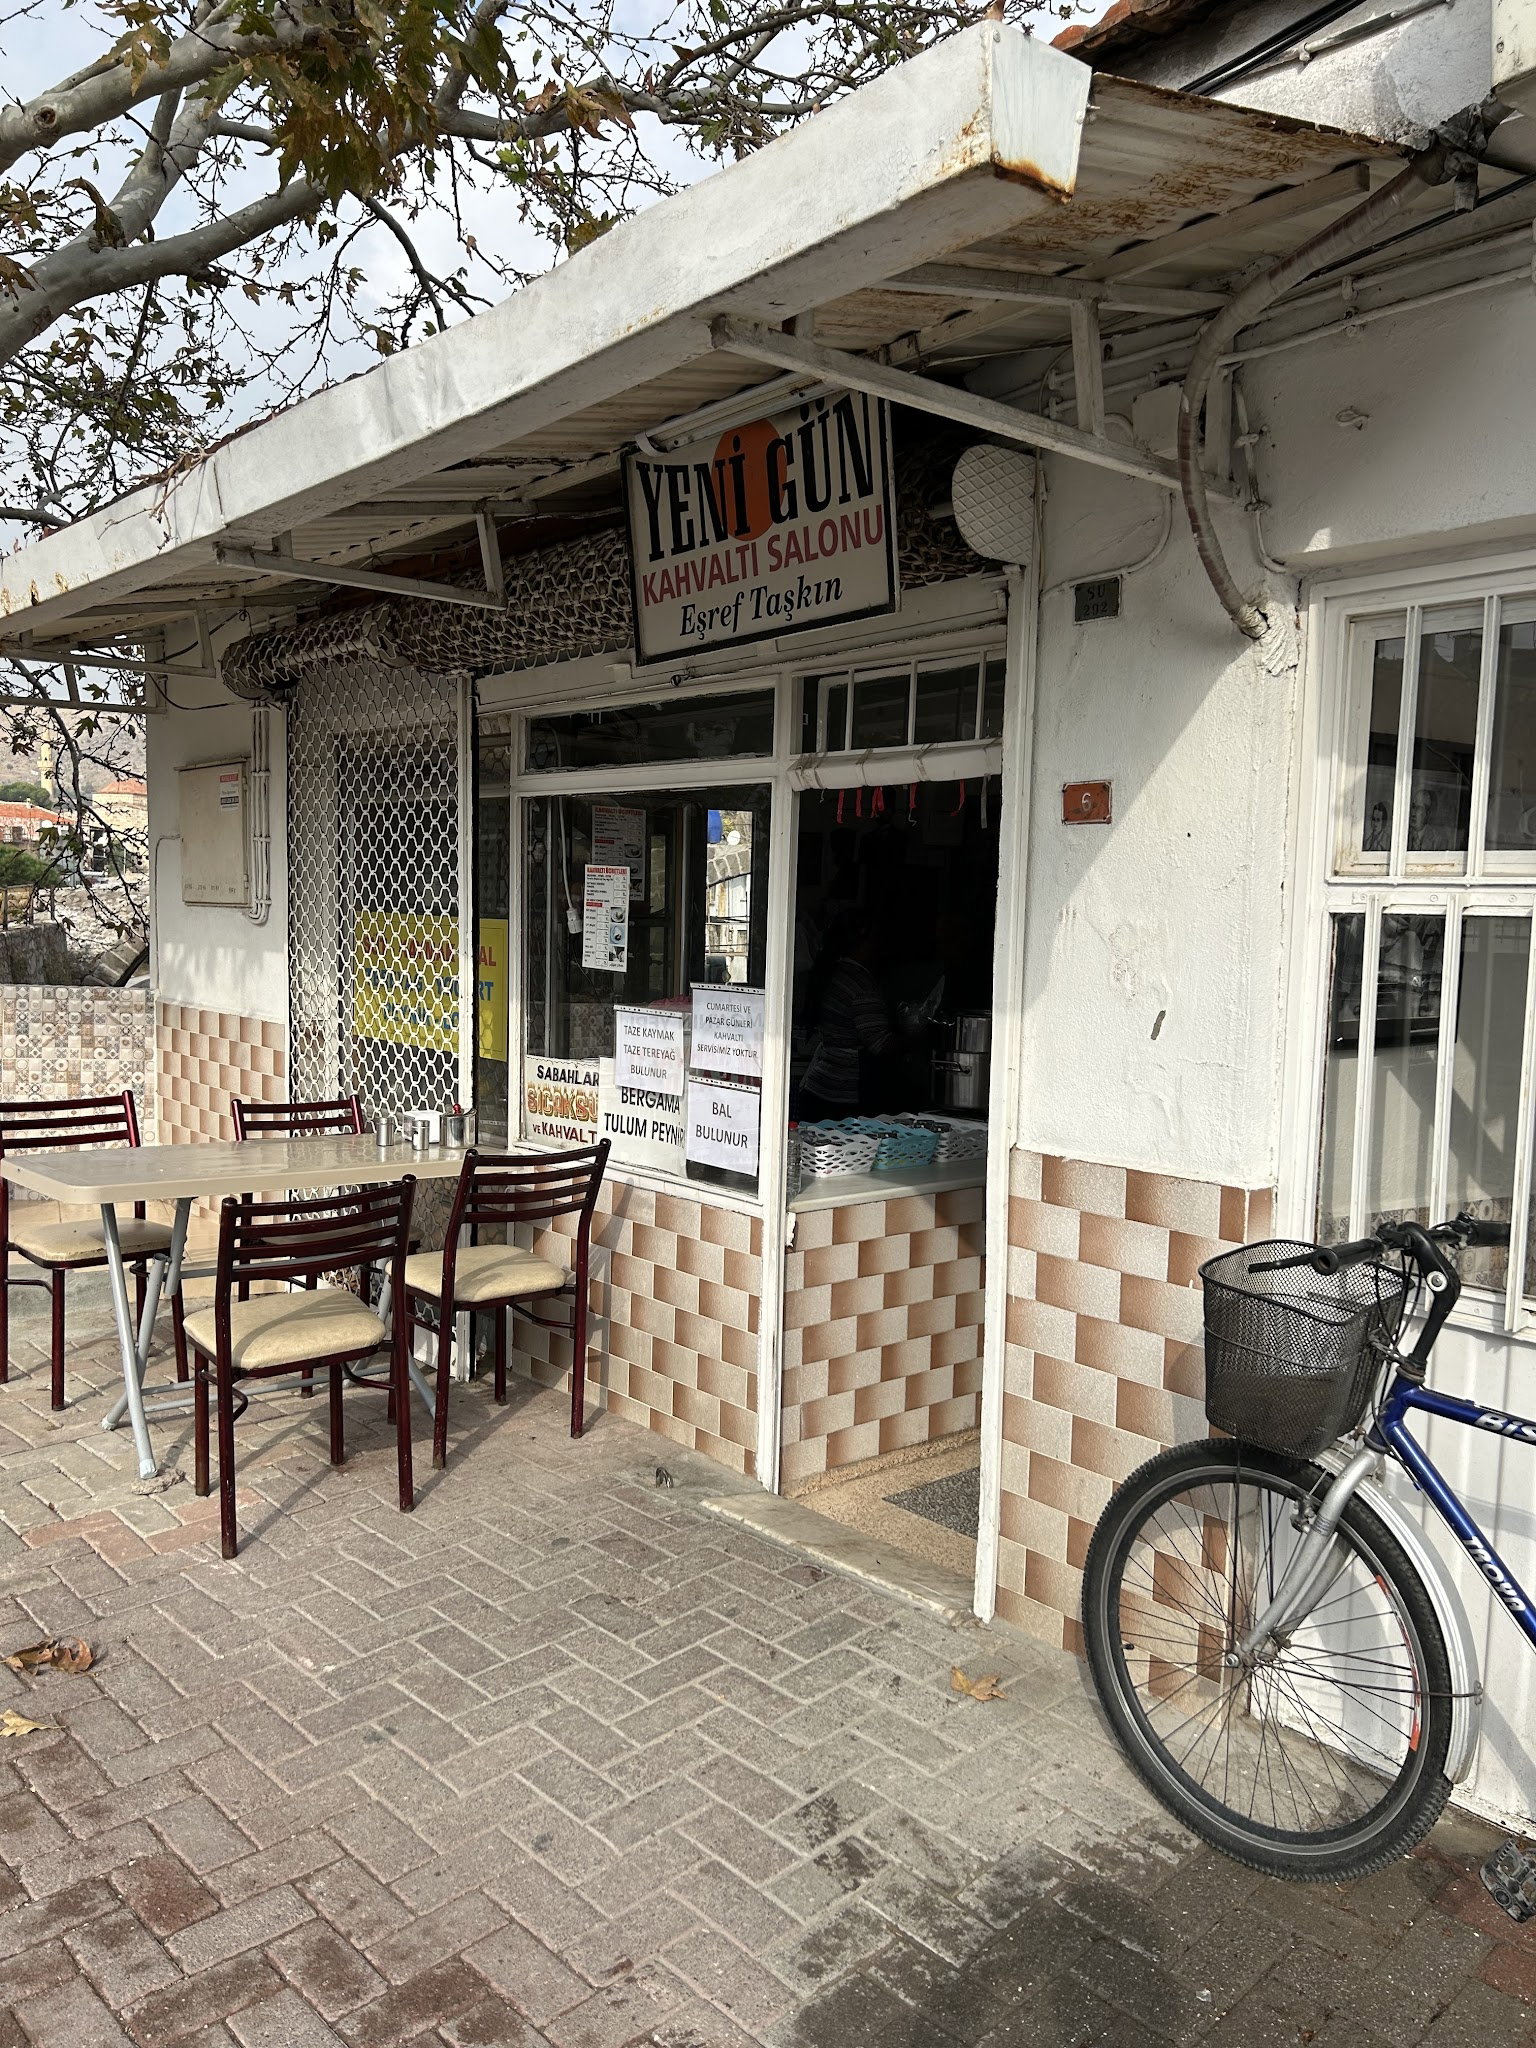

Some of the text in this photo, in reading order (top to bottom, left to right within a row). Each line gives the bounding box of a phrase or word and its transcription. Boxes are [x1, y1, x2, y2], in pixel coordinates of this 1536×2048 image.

[635, 389, 874, 562] YENİ GÜN
[643, 504, 884, 606] KAHVALTI SALONU
[1087, 583, 1105, 601] SU
[679, 575, 843, 640] Eşref Taşkın
[1081, 792, 1092, 812] 6
[479, 946, 497, 967] AL
[706, 1002, 752, 1014] CUMARTESİ VE
[705, 1016, 753, 1029] PAZAR GÜNLERİ
[624, 1025, 675, 1042] TAZE KAYMAK
[714, 1031, 744, 1042] KAHVALTI
[624, 1044, 676, 1061] TAZE TEREYAĞ
[630, 1064, 667, 1080] BULUNUR
[621, 1086, 681, 1115] BERGAMA
[712, 1101, 732, 1118] BAL
[604, 1112, 647, 1138] TULUM
[695, 1124, 748, 1149] BULUNUR
[1462, 1536, 1527, 1612] TROYA
